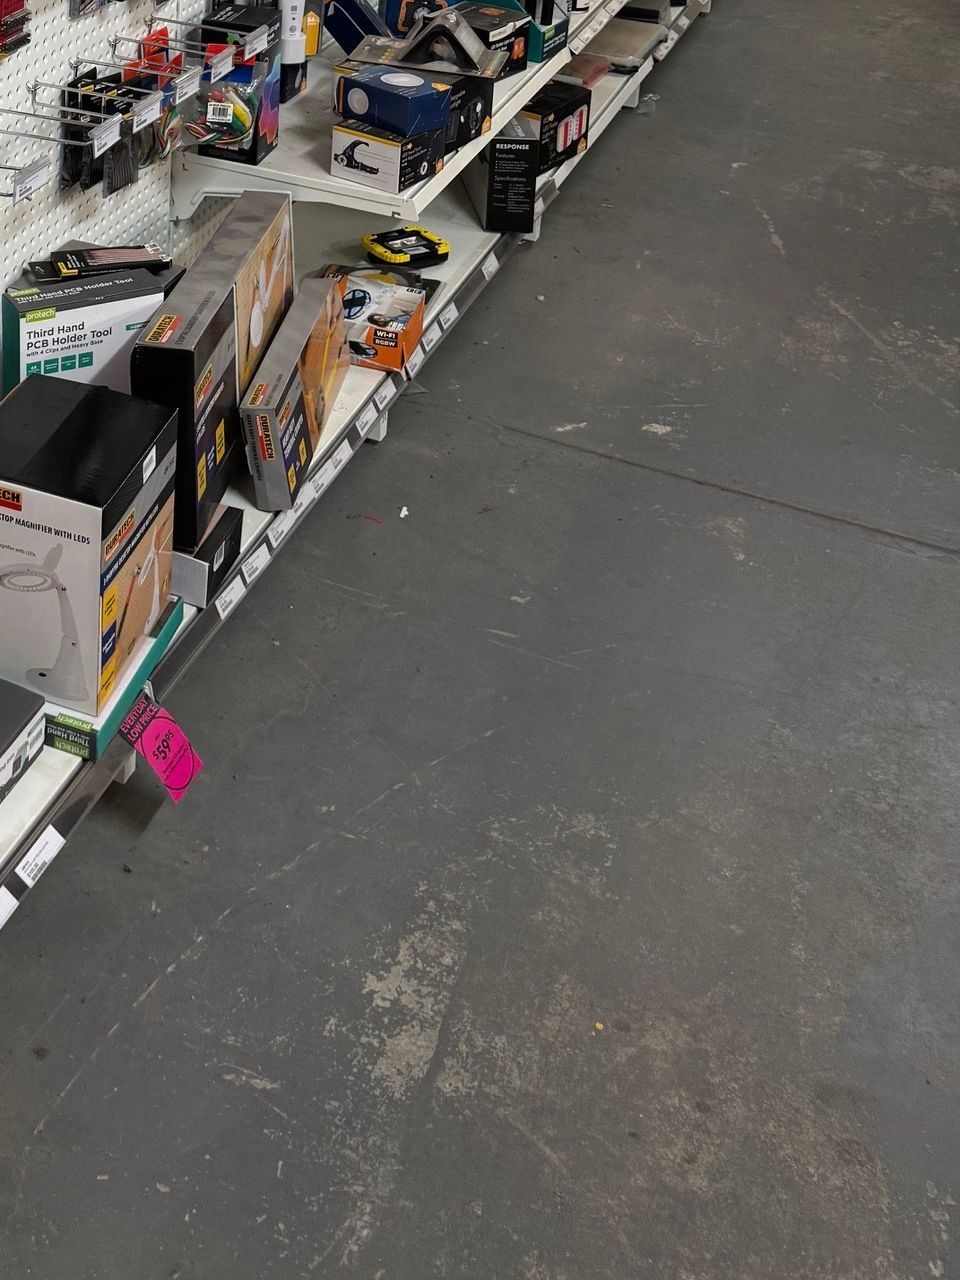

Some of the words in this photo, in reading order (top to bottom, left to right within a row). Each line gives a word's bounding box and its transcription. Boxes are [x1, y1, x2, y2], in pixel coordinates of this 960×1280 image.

[496, 143, 530, 151] RESPONSE
[15, 294, 39, 303] Third
[39, 290, 63, 299] Hand
[64, 286, 83, 295] PCB
[84, 281, 113, 291] Holder
[115, 277, 134, 286] Tool
[26, 309, 55, 322] protech
[148, 314, 175, 343] DURATECH
[26, 327, 55, 340] Third
[57, 321, 85, 335] Hand
[26, 339, 49, 351] PCB
[52, 332, 88, 347] Holder
[90, 326, 113, 339] Tool
[376, 330, 396, 339] WI-FI
[26, 350, 39, 358] with
[44, 346, 59, 356] Clips
[60, 345, 71, 353] and
[71, 342, 90, 352] Heavy
[90, 339, 104, 347] Base
[260, 415, 275, 460] DURATECH
[14, 517, 53, 535] MAGNIFIER
[53, 526, 72, 540] WITH
[73, 533, 91, 545] LEDS
[105, 511, 135, 556] DURATECH
[121, 696, 149, 733] EVERYDAY
[127, 724, 144, 742] LOW
[141, 703, 158, 727] PRICE
